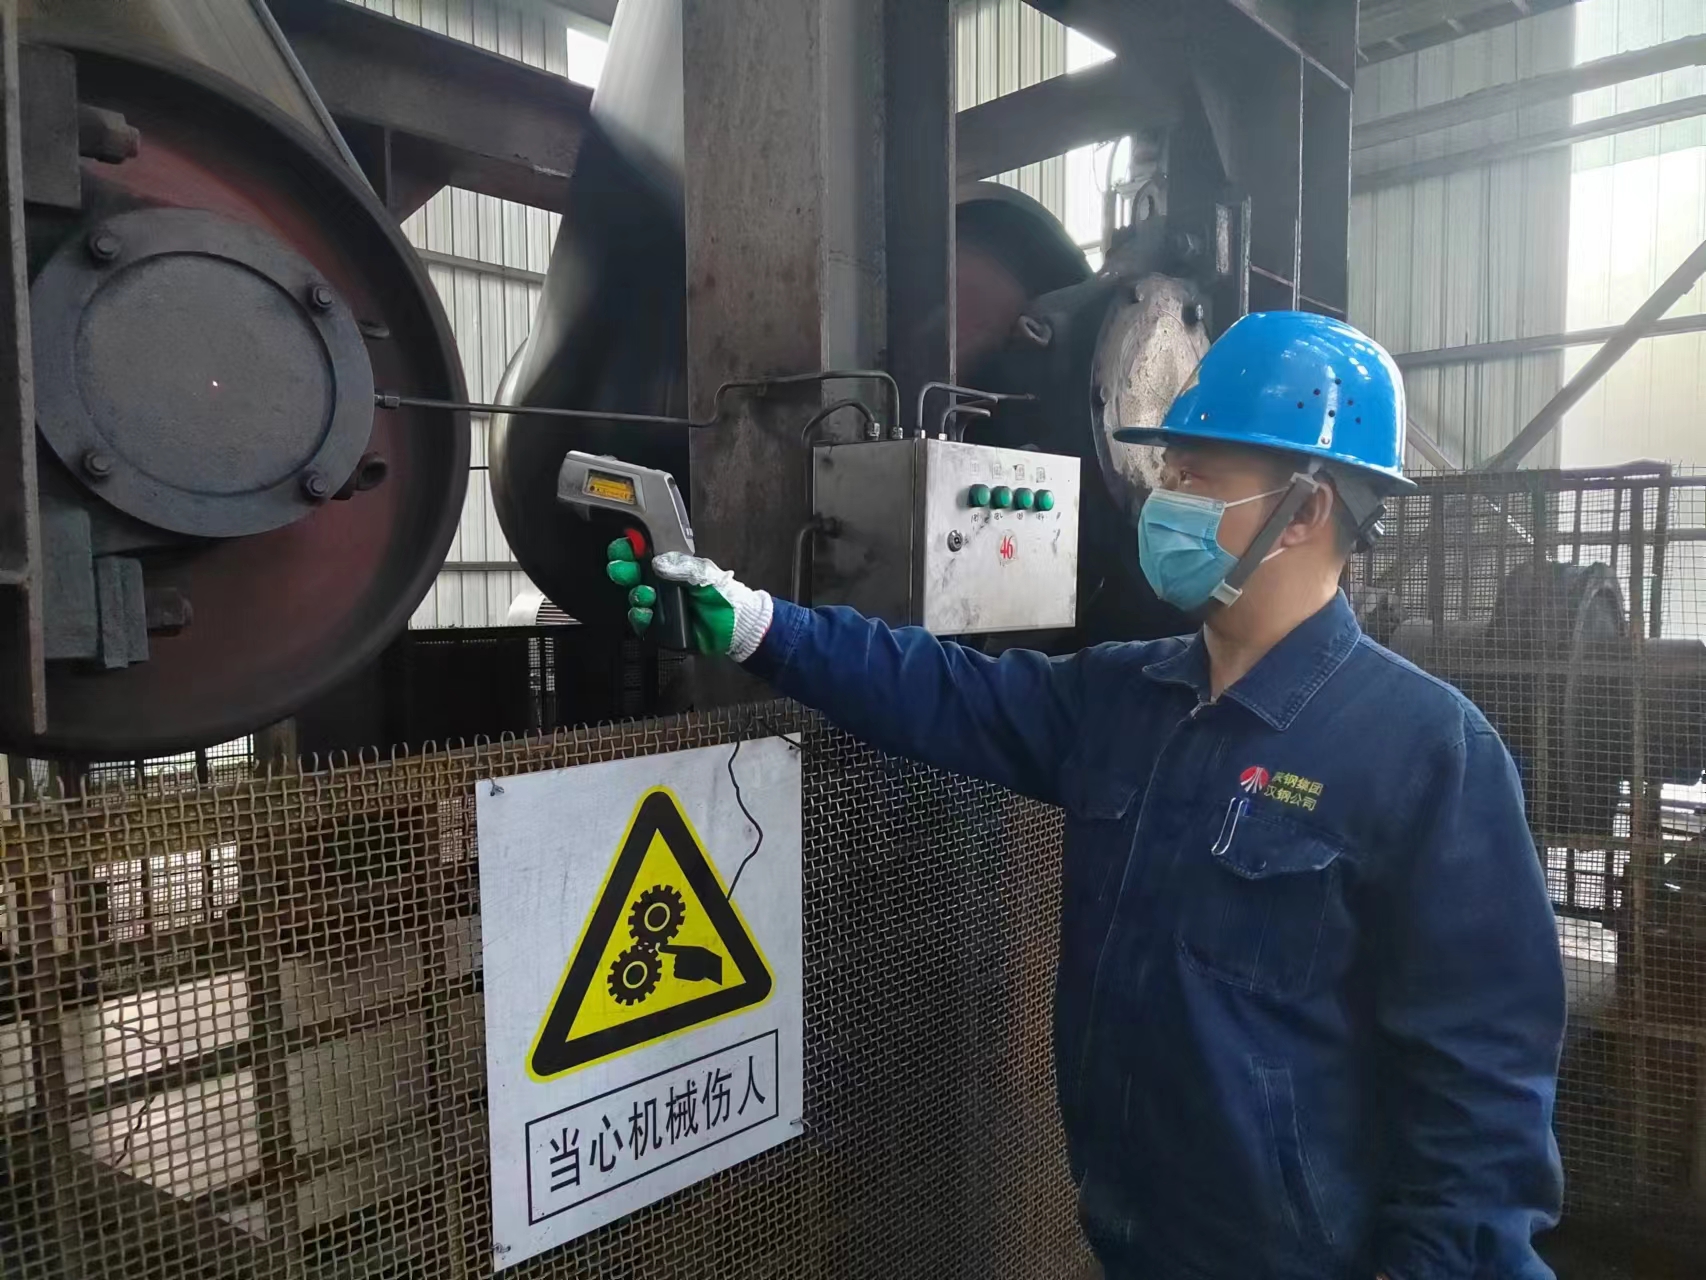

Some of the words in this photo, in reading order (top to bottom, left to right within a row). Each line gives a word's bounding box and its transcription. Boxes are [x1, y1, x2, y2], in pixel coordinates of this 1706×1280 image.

[1000, 535, 1013, 559] 46
[1264, 785, 1318, 812] 汉钢公司
[549, 1055, 767, 1193] 当心机械伤人
